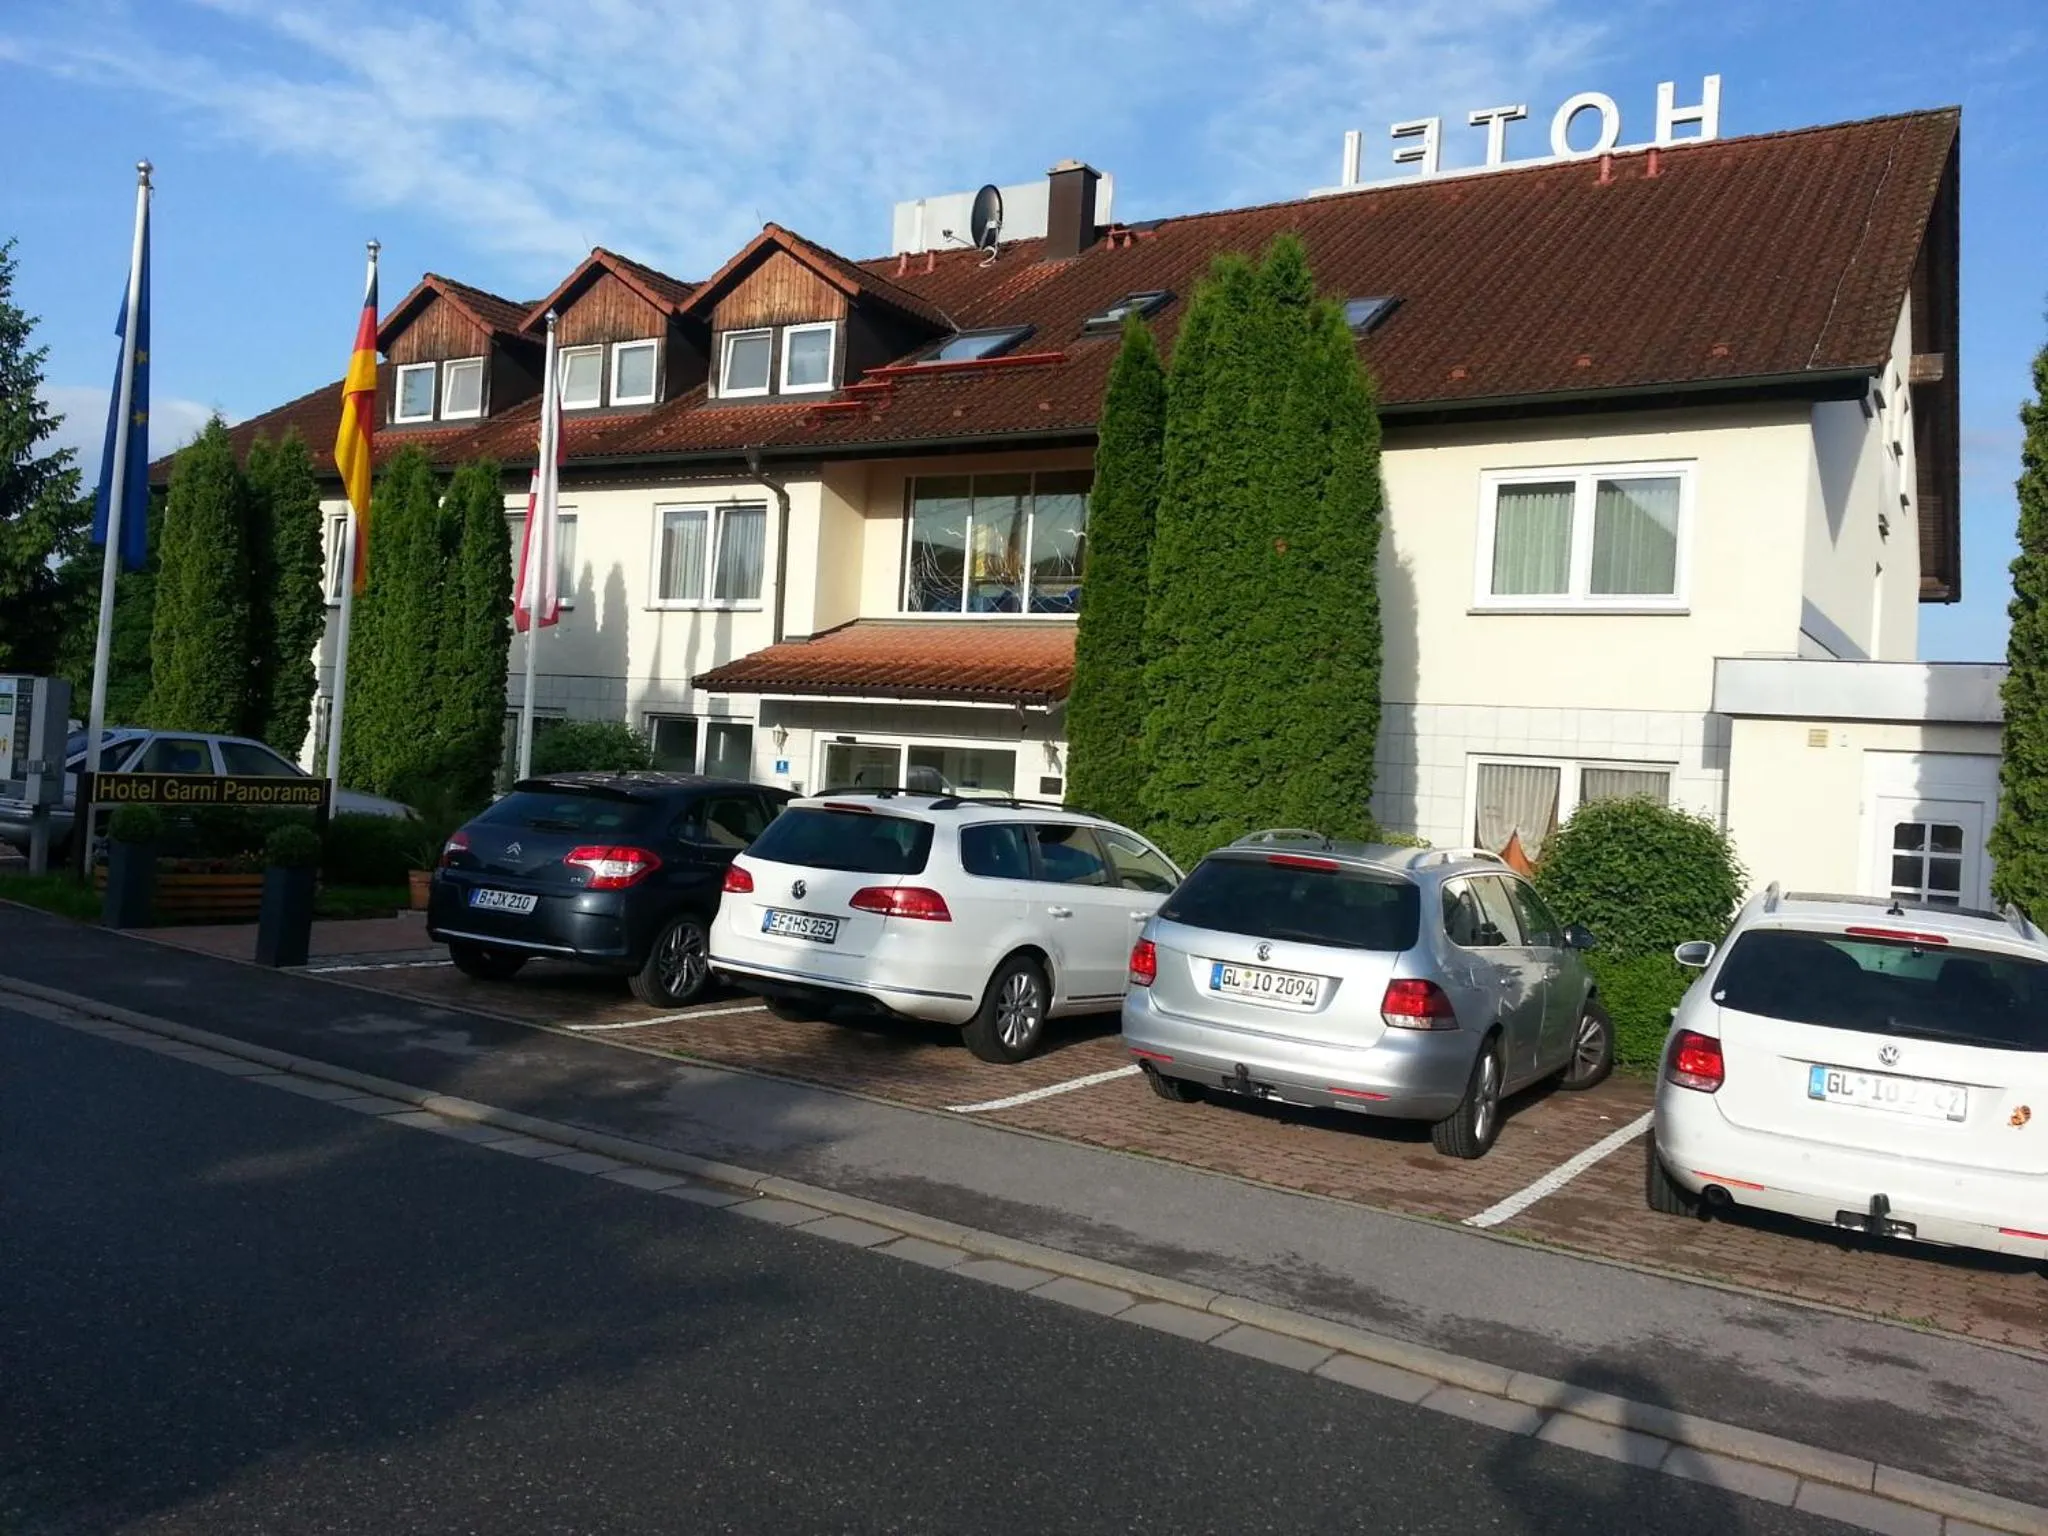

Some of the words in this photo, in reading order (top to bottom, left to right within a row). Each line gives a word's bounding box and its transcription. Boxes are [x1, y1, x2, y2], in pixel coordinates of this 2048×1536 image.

[100, 777, 157, 800] Hotel
[163, 778, 217, 800] Garni
[223, 780, 321, 802] Panorama
[508, 895, 531, 910] 210
[771, 911, 788, 929] EF
[793, 915, 809, 932] HS
[810, 920, 834, 937] 252
[1222, 968, 1241, 987] GL
[1275, 976, 1314, 999] 2094
[1827, 1072, 1854, 1096] GL
